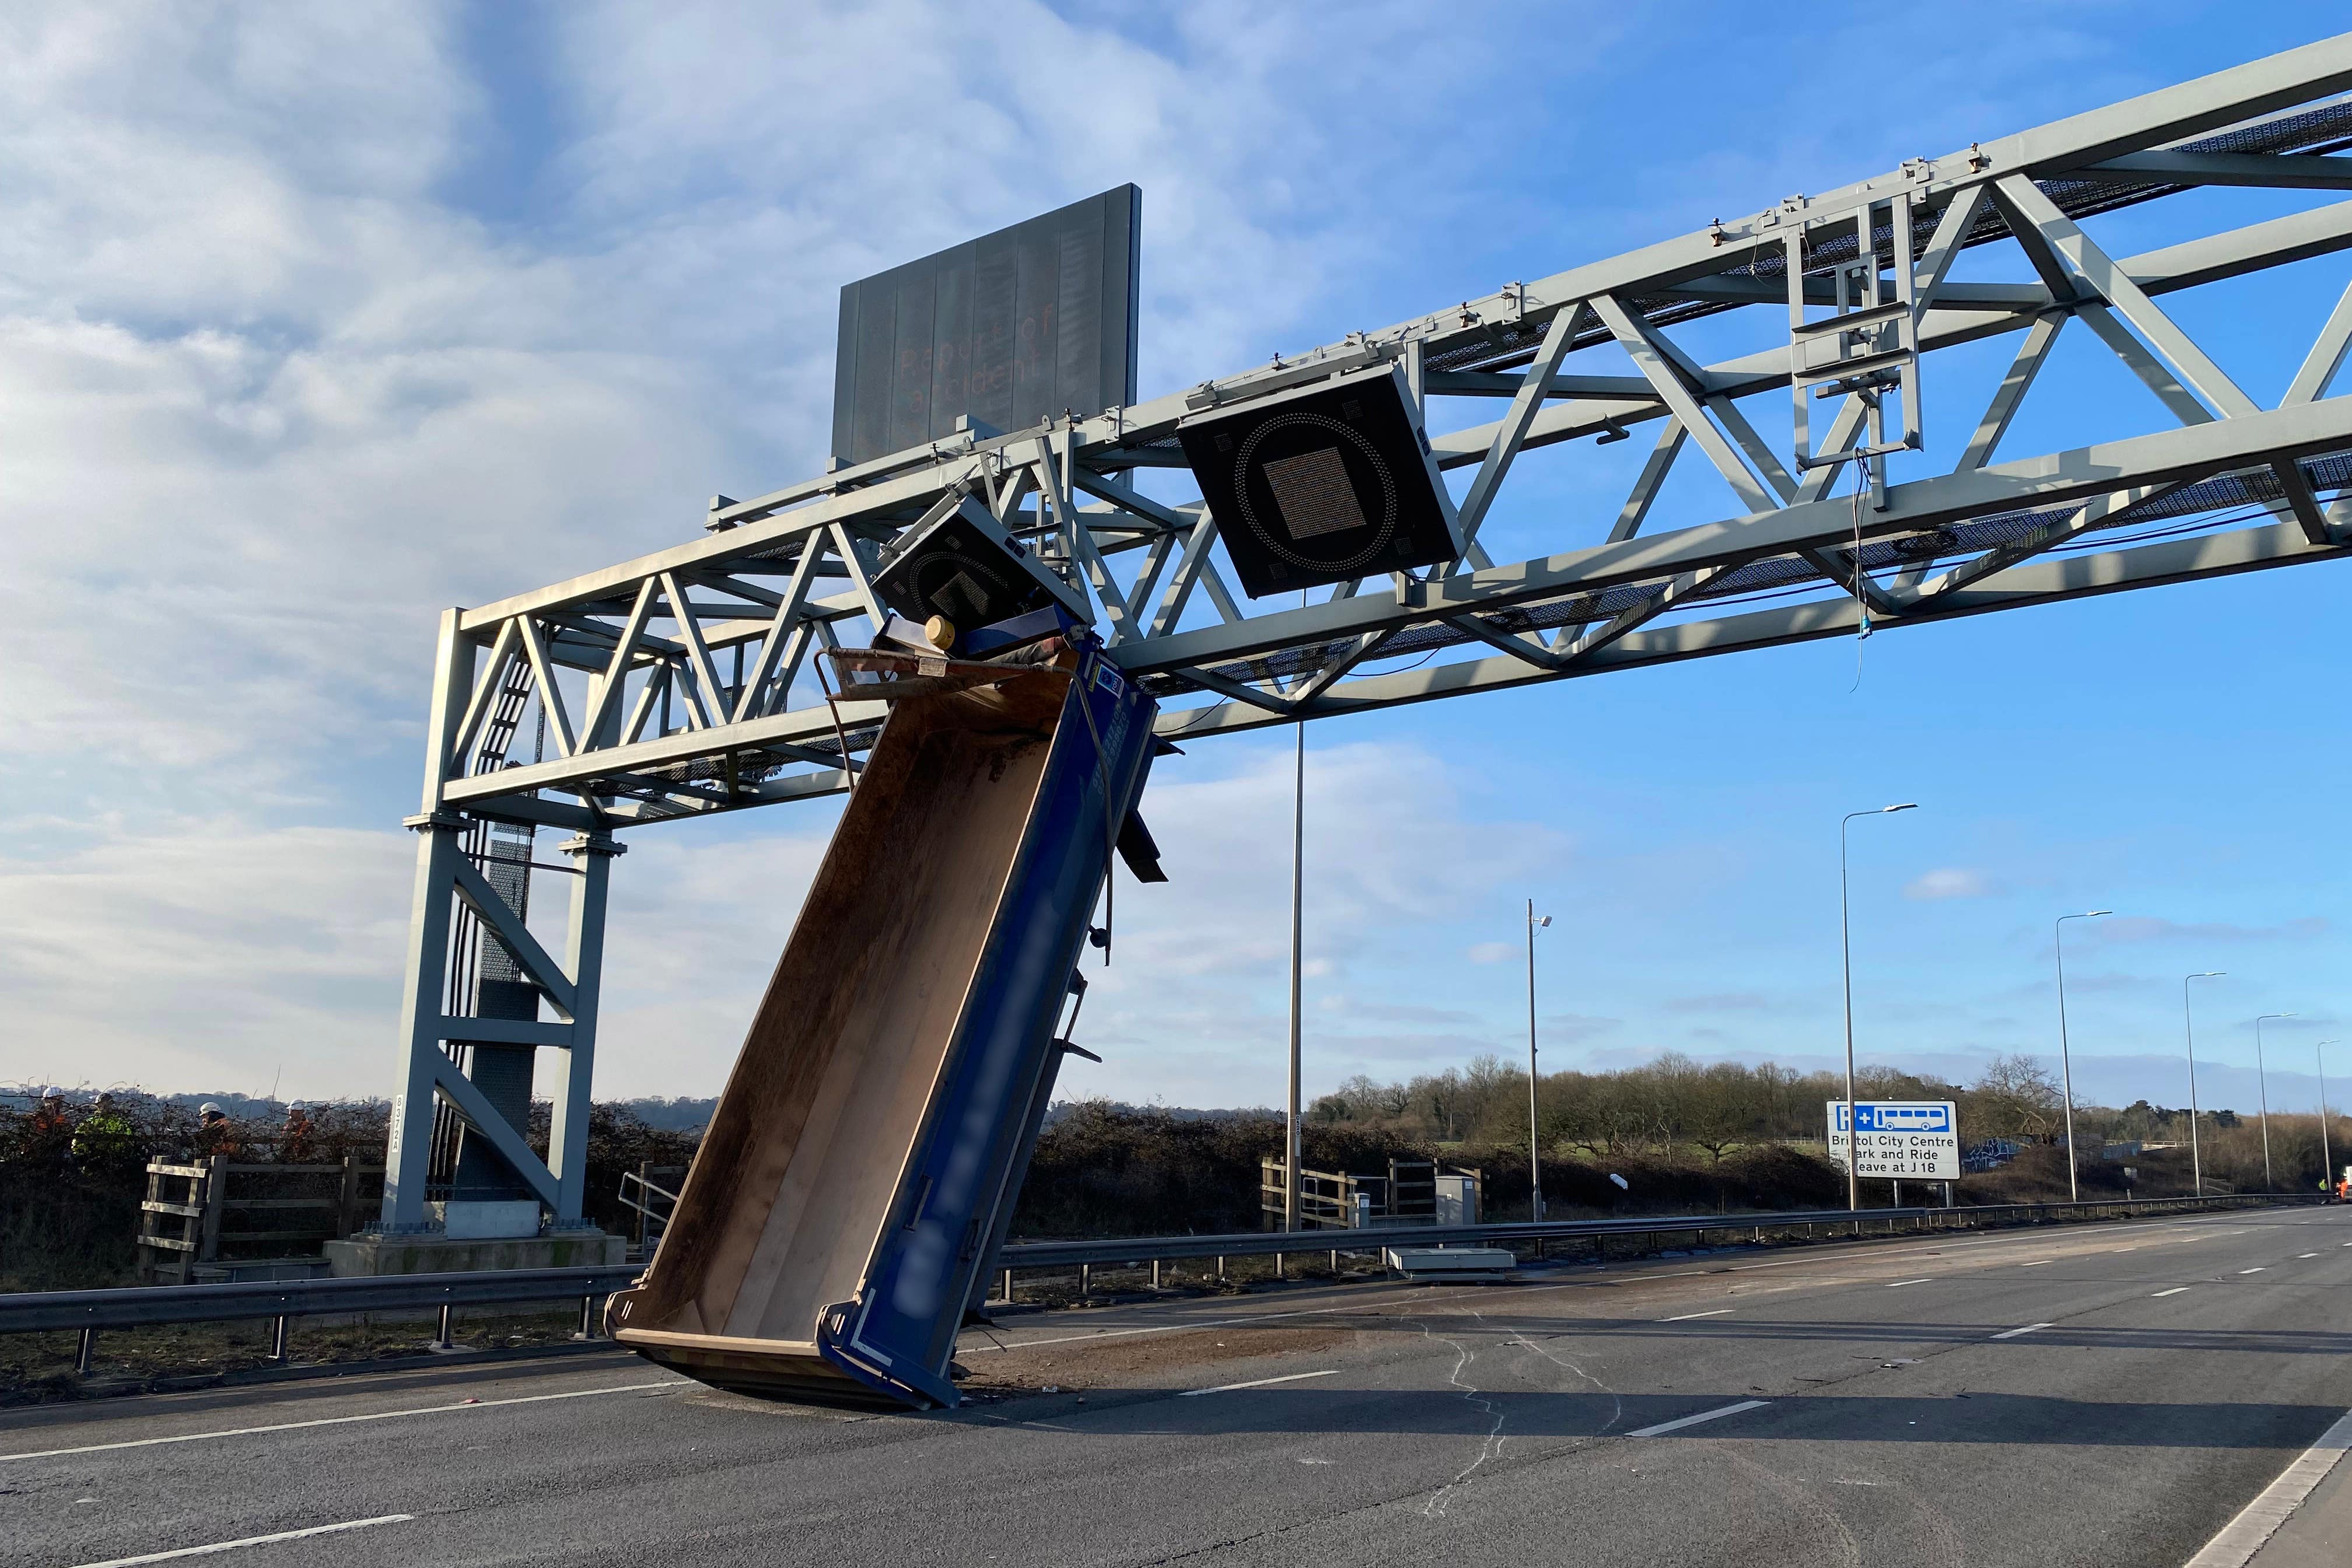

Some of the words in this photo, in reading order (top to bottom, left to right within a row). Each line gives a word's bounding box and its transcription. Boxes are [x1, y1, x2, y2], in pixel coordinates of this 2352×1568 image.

[393, 1097, 402, 1150] 8372A
[1832, 1135, 1873, 1146] Britol
[1878, 1136, 1903, 1147] City
[1910, 1136, 1954, 1147] Centre
[1848, 1149, 1875, 1158] ark
[1881, 1150, 1903, 1159] and
[1910, 1150, 1938, 1160] Ride
[1857, 1163, 1887, 1172] eave
[1893, 1163, 1905, 1172] at
